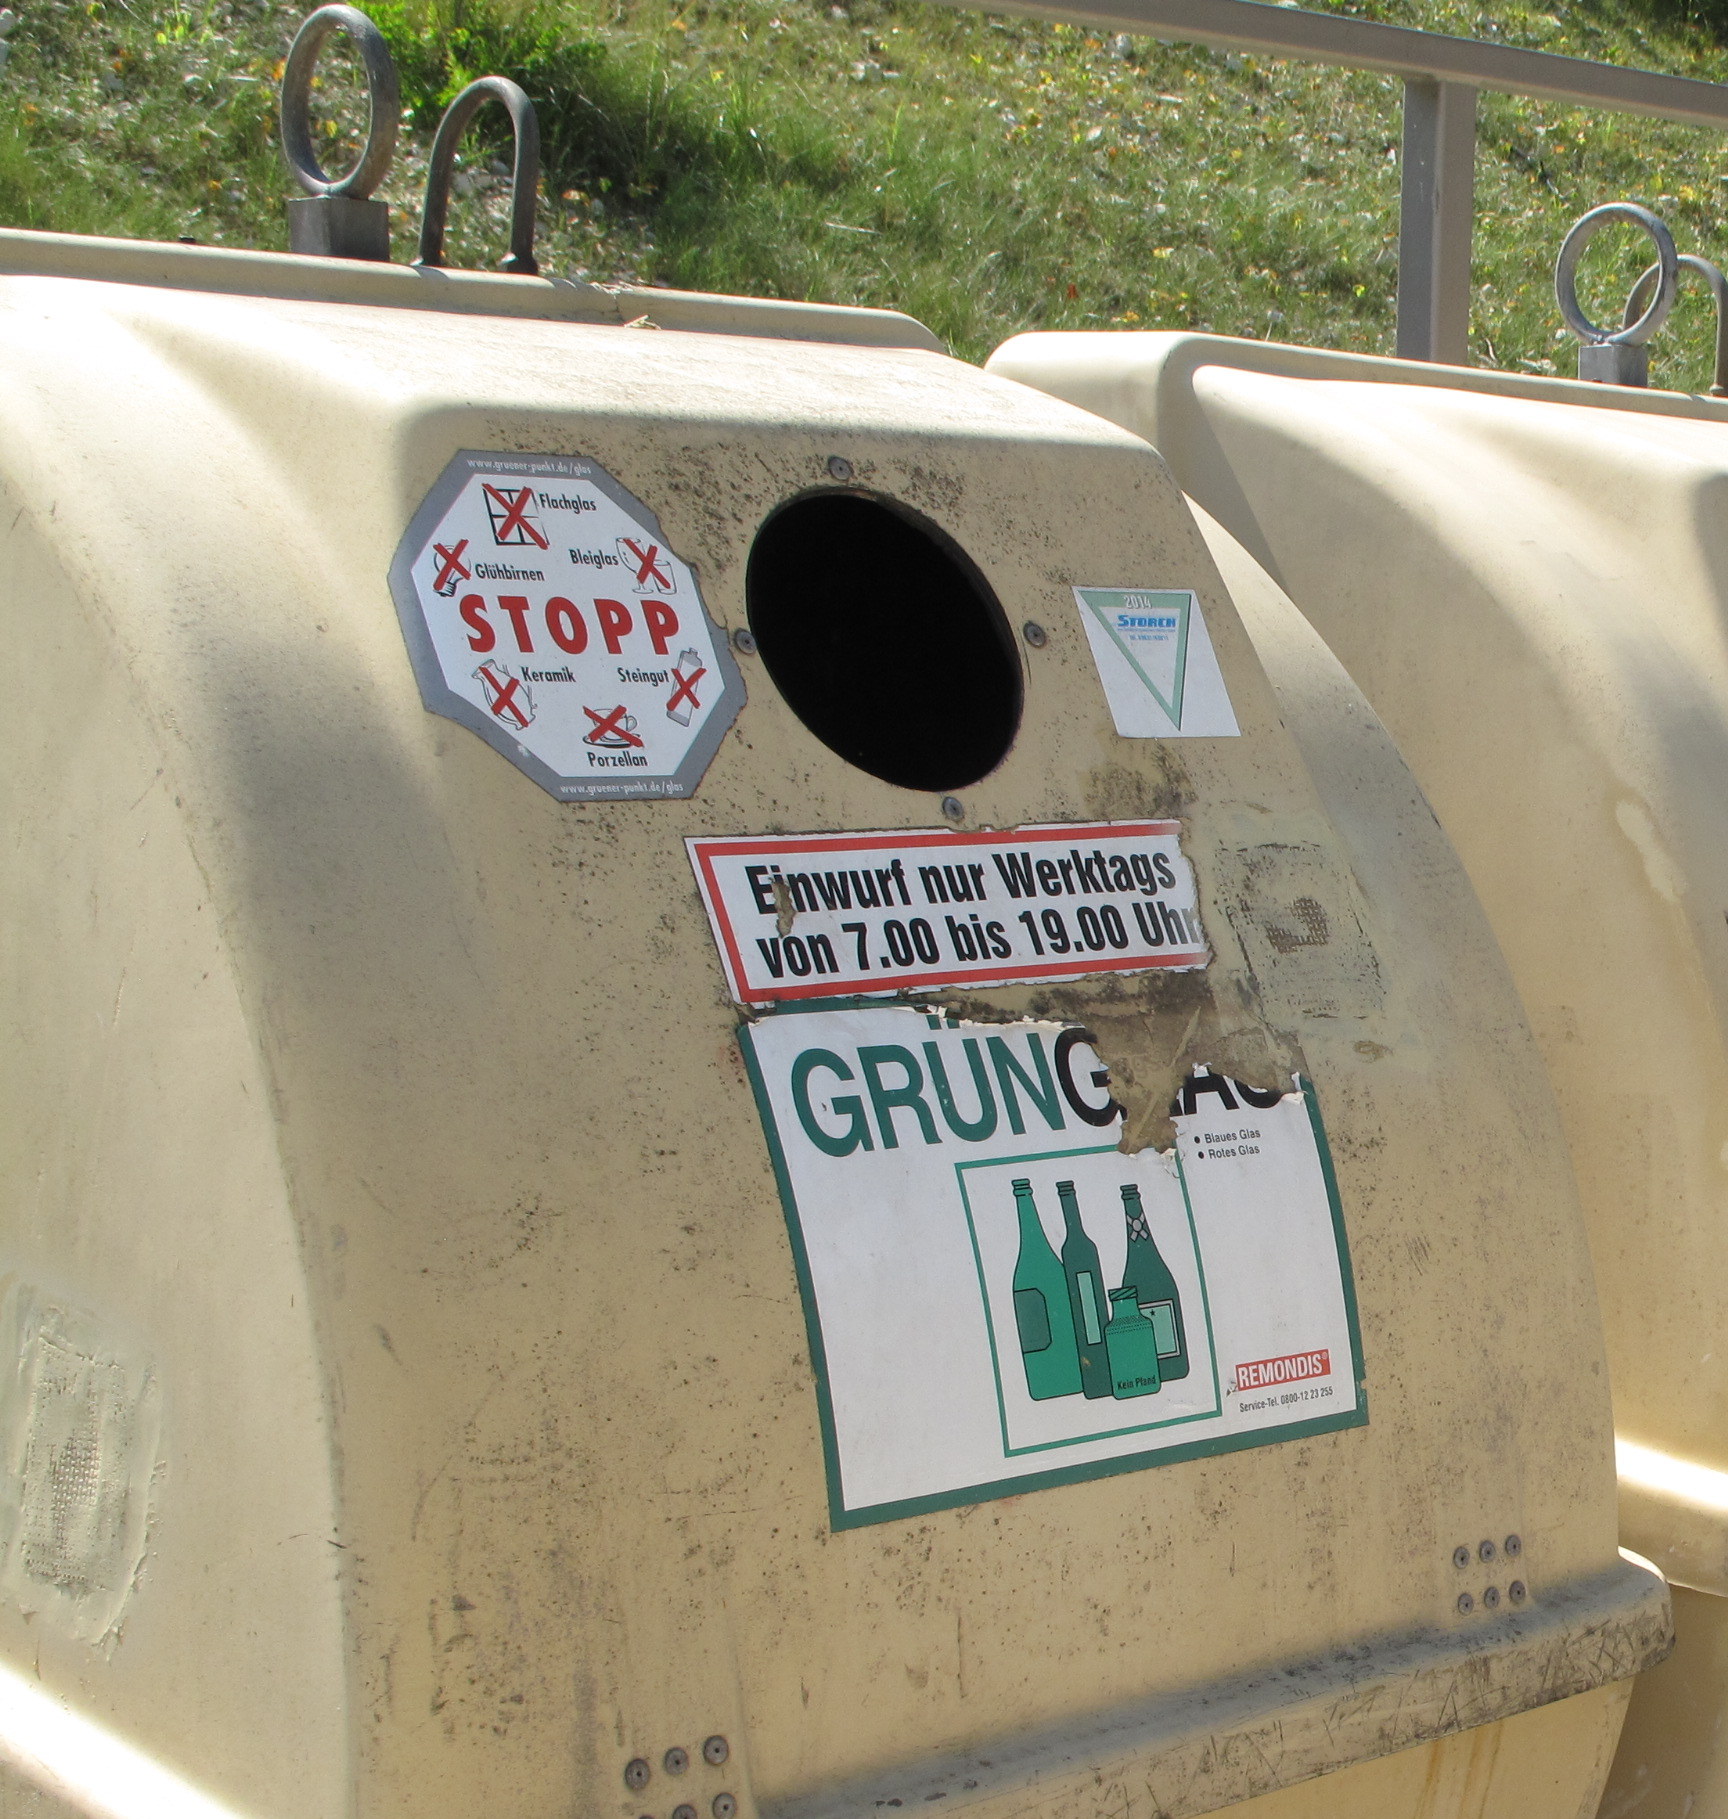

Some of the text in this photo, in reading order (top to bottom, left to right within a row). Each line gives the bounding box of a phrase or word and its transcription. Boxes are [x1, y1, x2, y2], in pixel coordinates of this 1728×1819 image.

[466, 458, 592, 477] www.gruener-punkt.de/glas
[539, 493, 597, 515] Flachglas
[569, 549, 619, 569] Bleiglas
[475, 562, 545, 582] Glühbirnen
[1123, 594, 1153, 610] 2014
[459, 593, 680, 655] STOPP
[521, 665, 577, 683] Keramik
[617, 667, 670, 688] Steingut
[587, 751, 648, 768] Porzellan
[560, 780, 684, 796] www.gruener-punkt.de/glas
[744, 849, 1177, 915] Einwurf nur Werktags
[756, 900, 1202, 979] von 7.00 bis 19.00 Uhr
[790, 1014, 1282, 1158] GRÜNGA
[1204, 1129, 1261, 1144] Blaues Glas
[1208, 1144, 1260, 1160] Rotes Glas
[1117, 1379, 1134, 1390] Kein
[1239, 1385, 1334, 1413] Service-Tel. 0800-12 23 255
